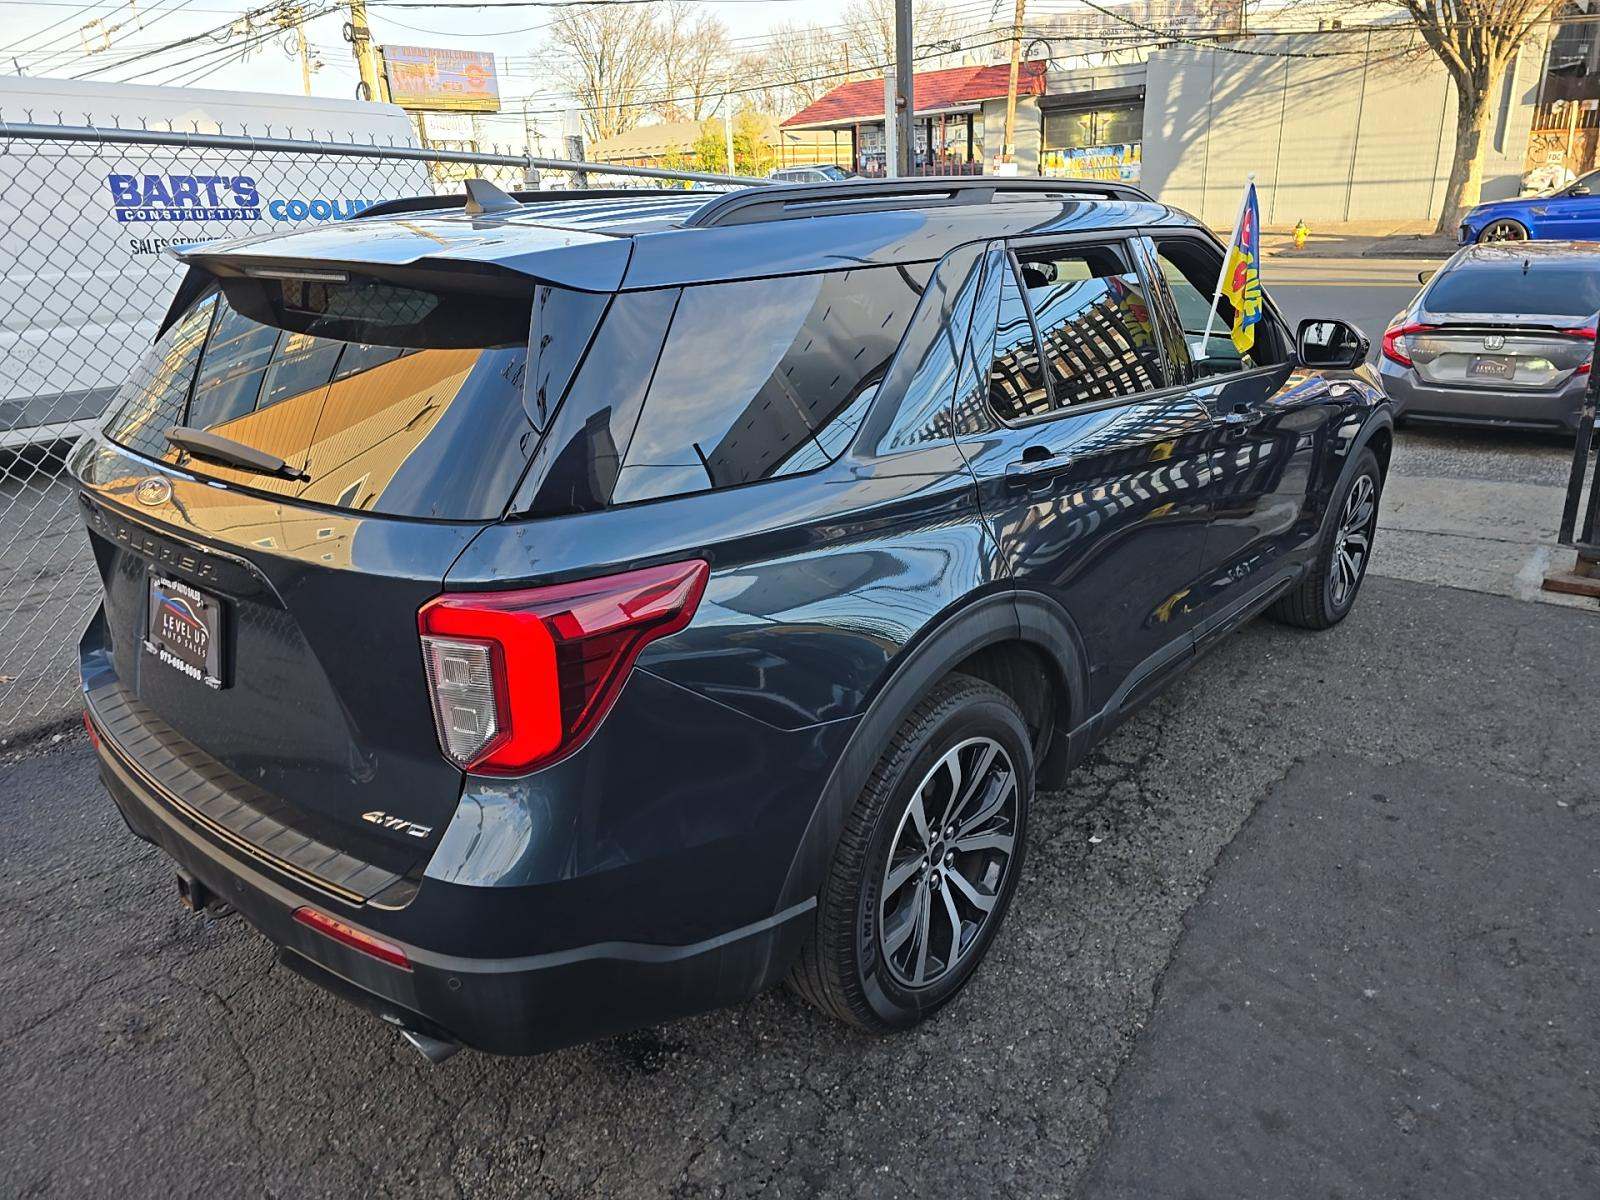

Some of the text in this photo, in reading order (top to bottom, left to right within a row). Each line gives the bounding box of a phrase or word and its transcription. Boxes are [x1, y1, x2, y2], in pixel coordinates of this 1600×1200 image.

[108, 174, 260, 207] BART'S
[124, 209, 256, 221] CONSTRUCTION
[130, 238, 168, 255] SALES
[162, 628, 207, 658] AUTO SALES
[163, 613, 206, 647] LEVEL UP
[361, 811, 433, 838] 4WD
